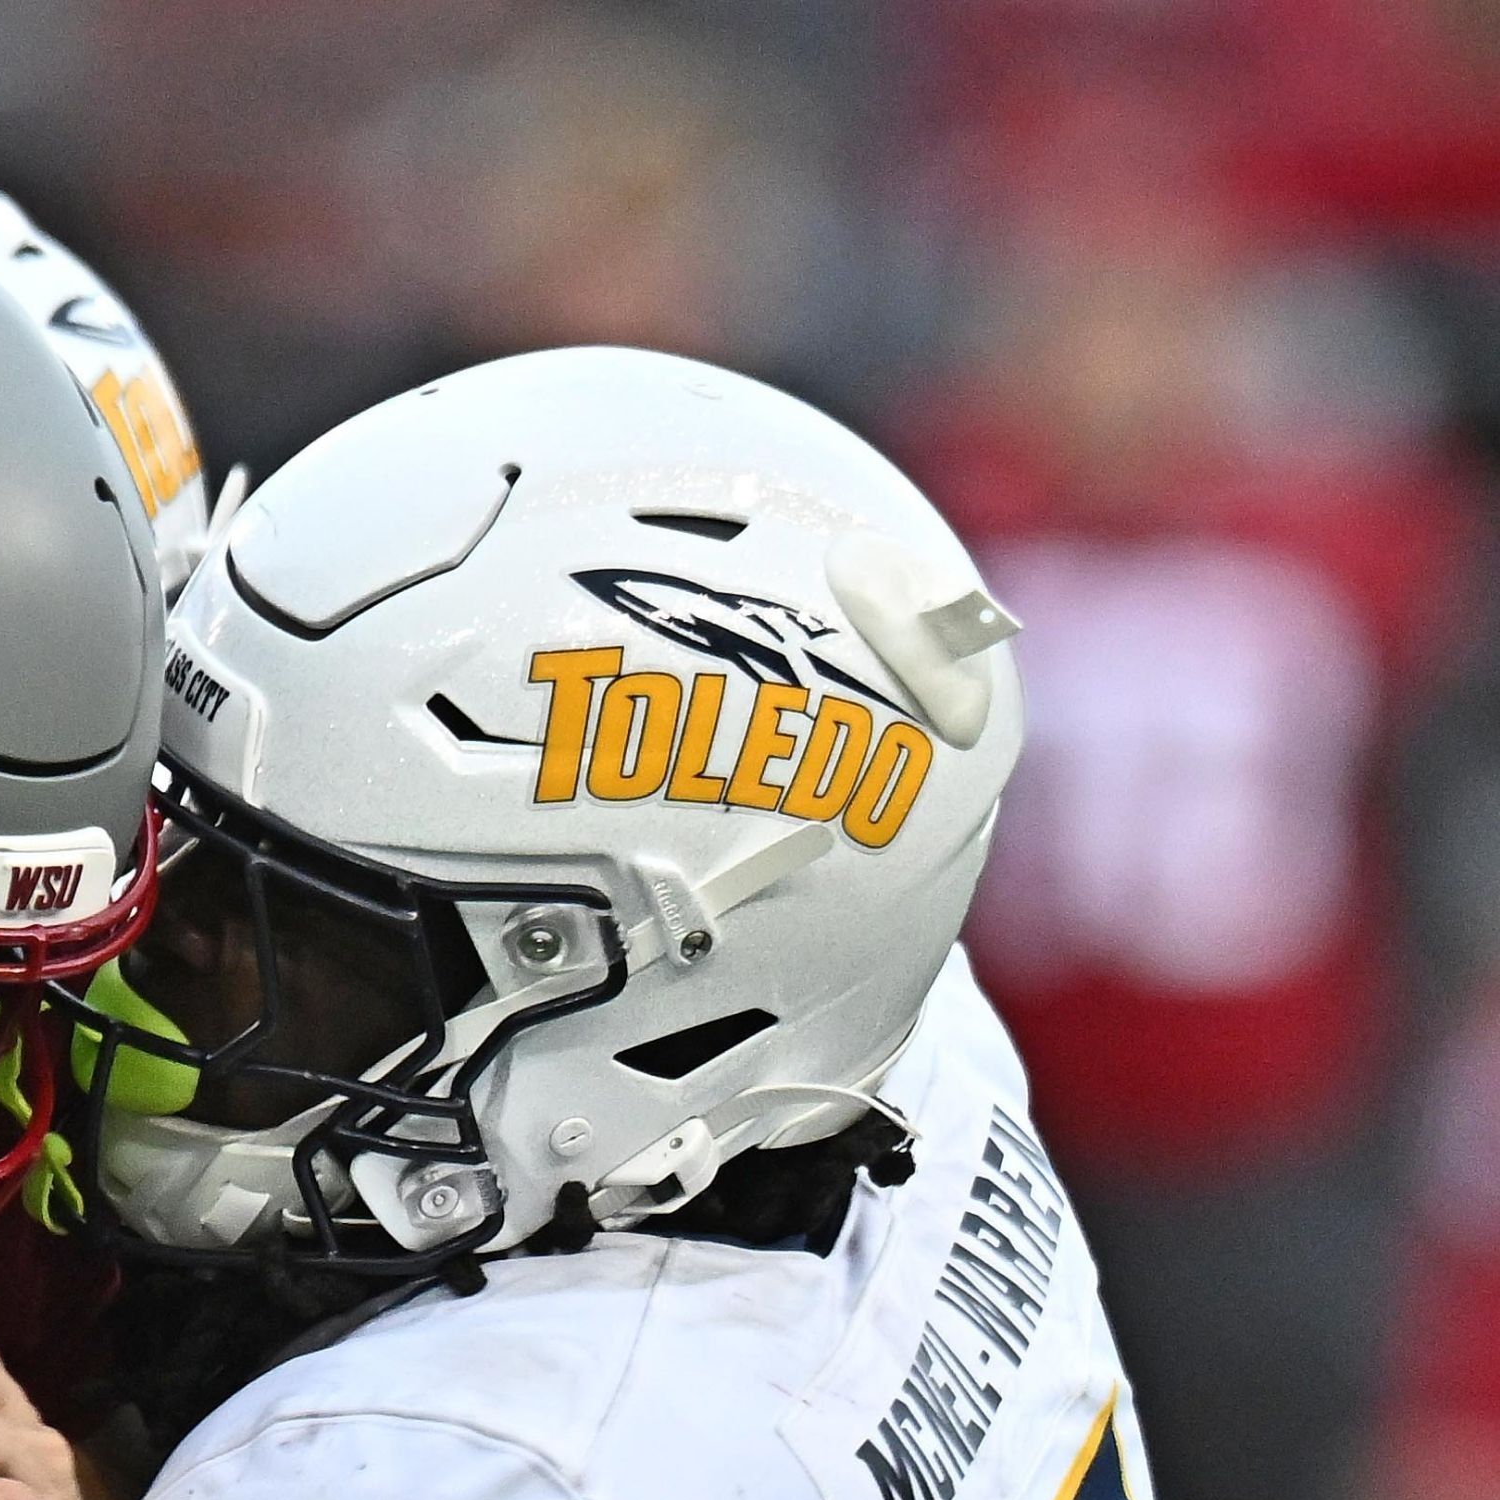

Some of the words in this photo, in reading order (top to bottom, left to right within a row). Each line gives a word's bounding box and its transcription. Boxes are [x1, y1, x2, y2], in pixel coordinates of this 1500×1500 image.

[184, 668, 230, 722] CITY
[528, 646, 933, 849] TOLEDO
[5, 864, 83, 911] WSU
